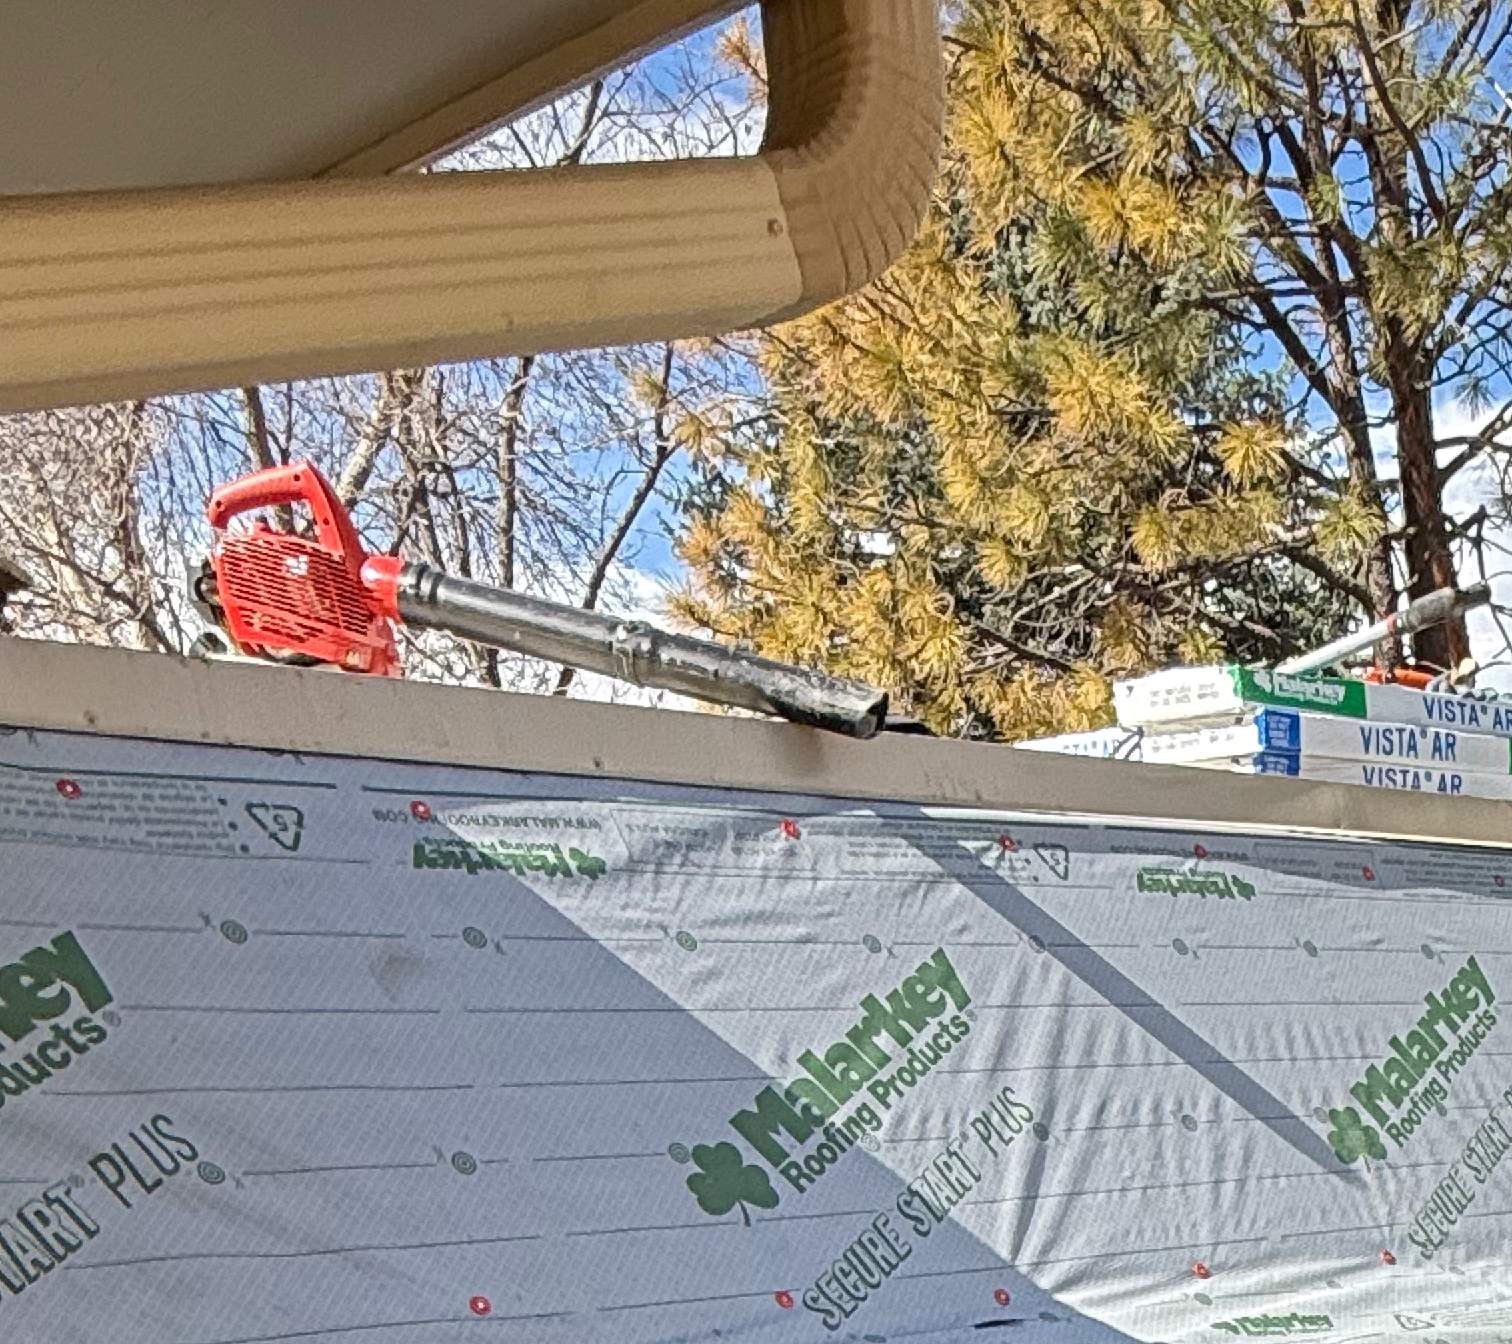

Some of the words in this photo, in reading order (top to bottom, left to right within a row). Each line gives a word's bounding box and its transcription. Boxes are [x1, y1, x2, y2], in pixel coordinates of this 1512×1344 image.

[1431, 731, 1457, 762] AR
[728, 947, 972, 1169] Malarkey
[1350, 955, 1496, 1128] Malarkey
[779, 1102, 883, 1194] Roofing
[1385, 1077, 1448, 1148] Roofing
[89, 1115, 199, 1209] PLUS
[802, 1212, 913, 1331] SECURE
[970, 1086, 1034, 1158] PLUS
[1408, 1166, 1476, 1260] SECURE
